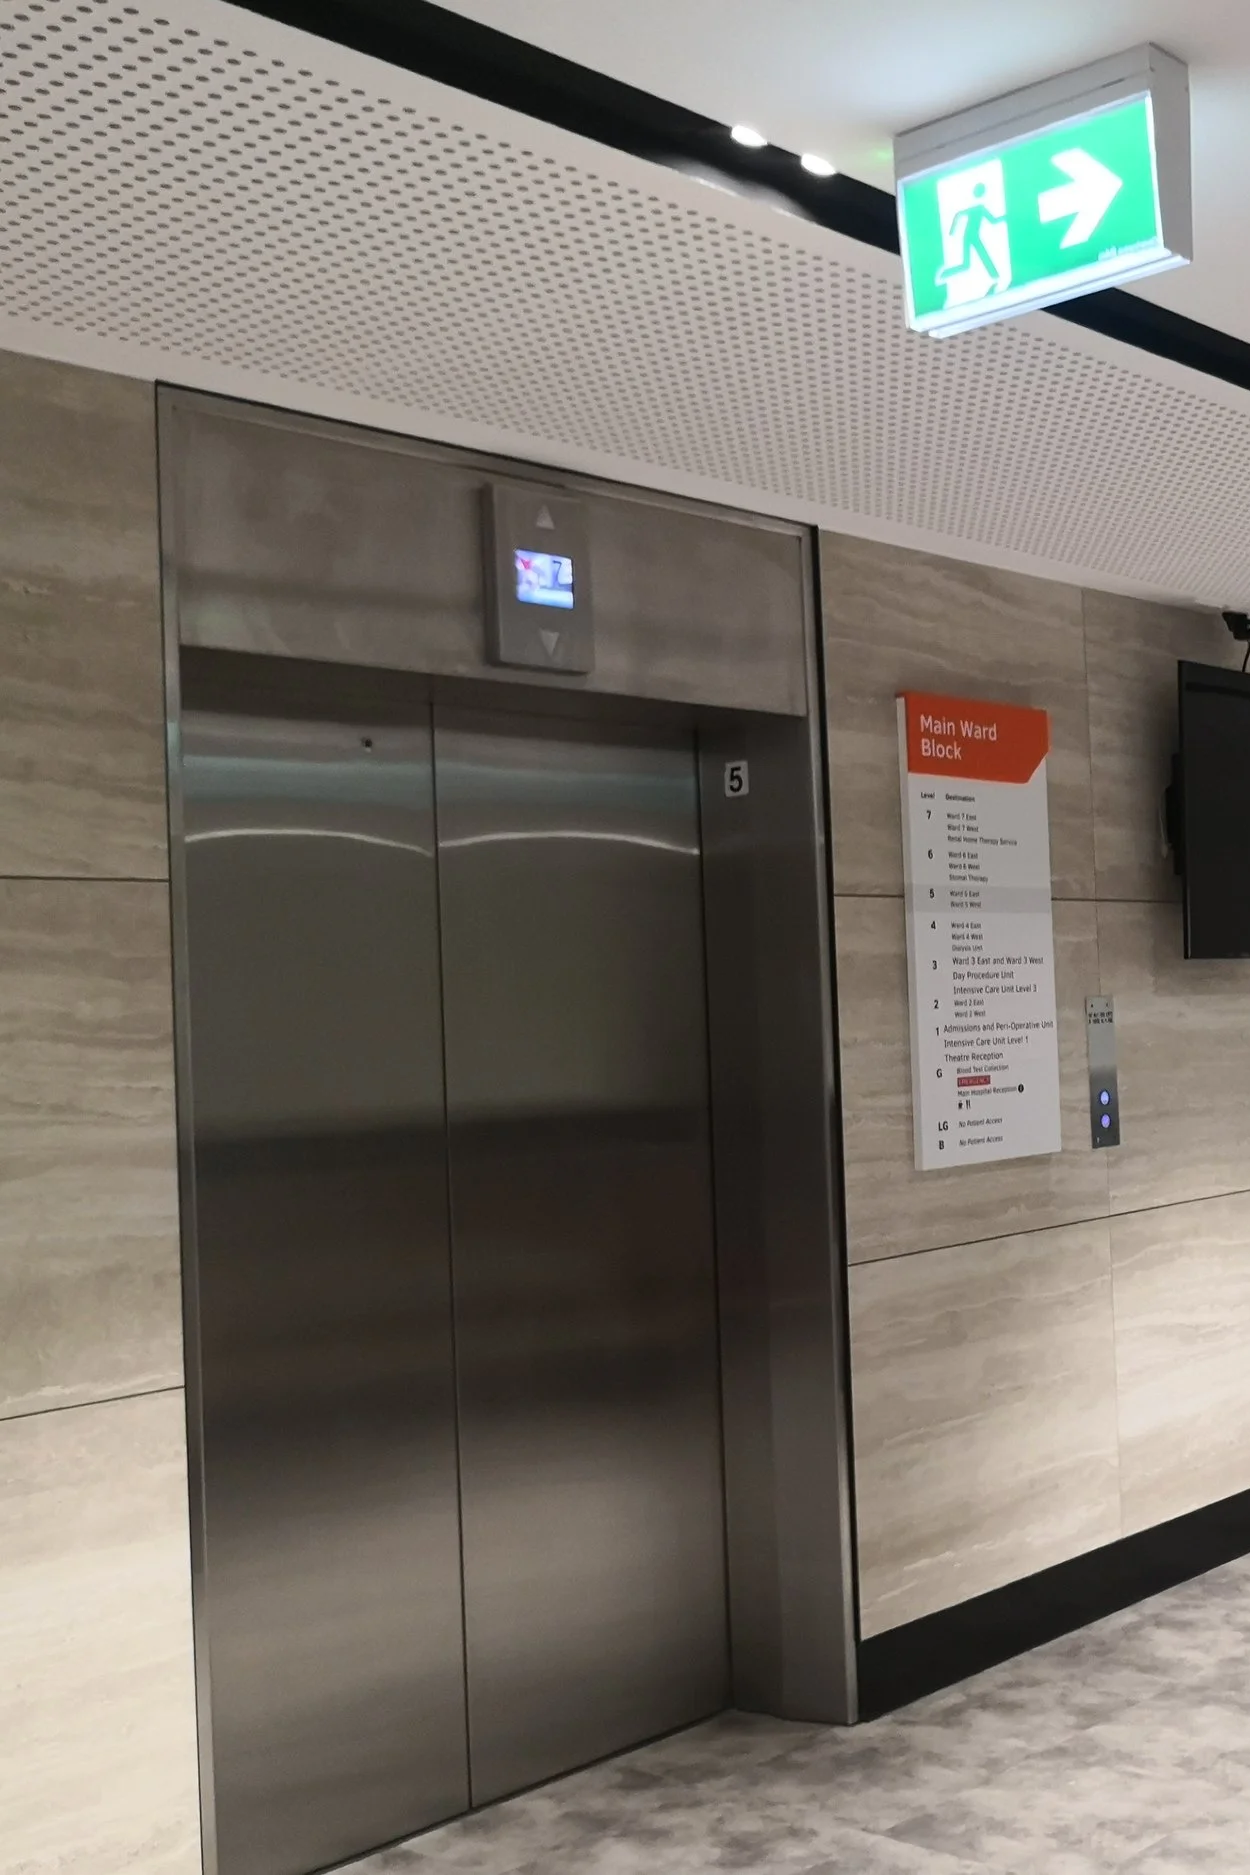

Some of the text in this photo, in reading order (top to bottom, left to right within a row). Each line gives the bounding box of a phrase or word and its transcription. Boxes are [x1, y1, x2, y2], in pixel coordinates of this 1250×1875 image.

[552, 560, 563, 581] 7
[920, 714, 998, 741] Main Ward
[921, 737, 962, 760] Block
[730, 766, 743, 793] 5
[920, 791, 935, 800] Level
[945, 793, 975, 802] Destination
[926, 810, 932, 820] 7
[928, 849, 933, 859] 6
[930, 888, 935, 899] 5
[931, 920, 936, 929] 4
[932, 960, 937, 970] 3
[952, 956, 1044, 965] Ward 3 East and Ward 3 West
[952, 971, 1014, 981] Day Procedure Unit
[953, 985, 983, 995] Intensive
[984, 985, 1000, 994] Care
[1001, 984, 1014, 993] Unit
[1015, 984, 1032, 993] Level
[933, 999, 939, 1009] 2
[936, 1027, 940, 1036] 1
[943, 1020, 1053, 1034] Admissions and Peri-Operative Unit
[944, 1035, 1029, 1048] Intensive Care Unit Level 1
[945, 1051, 1004, 1062] Theatre Reception
[936, 1068, 943, 1078] G
[938, 1120, 949, 1131] LG
[938, 1140, 944, 1150] B
